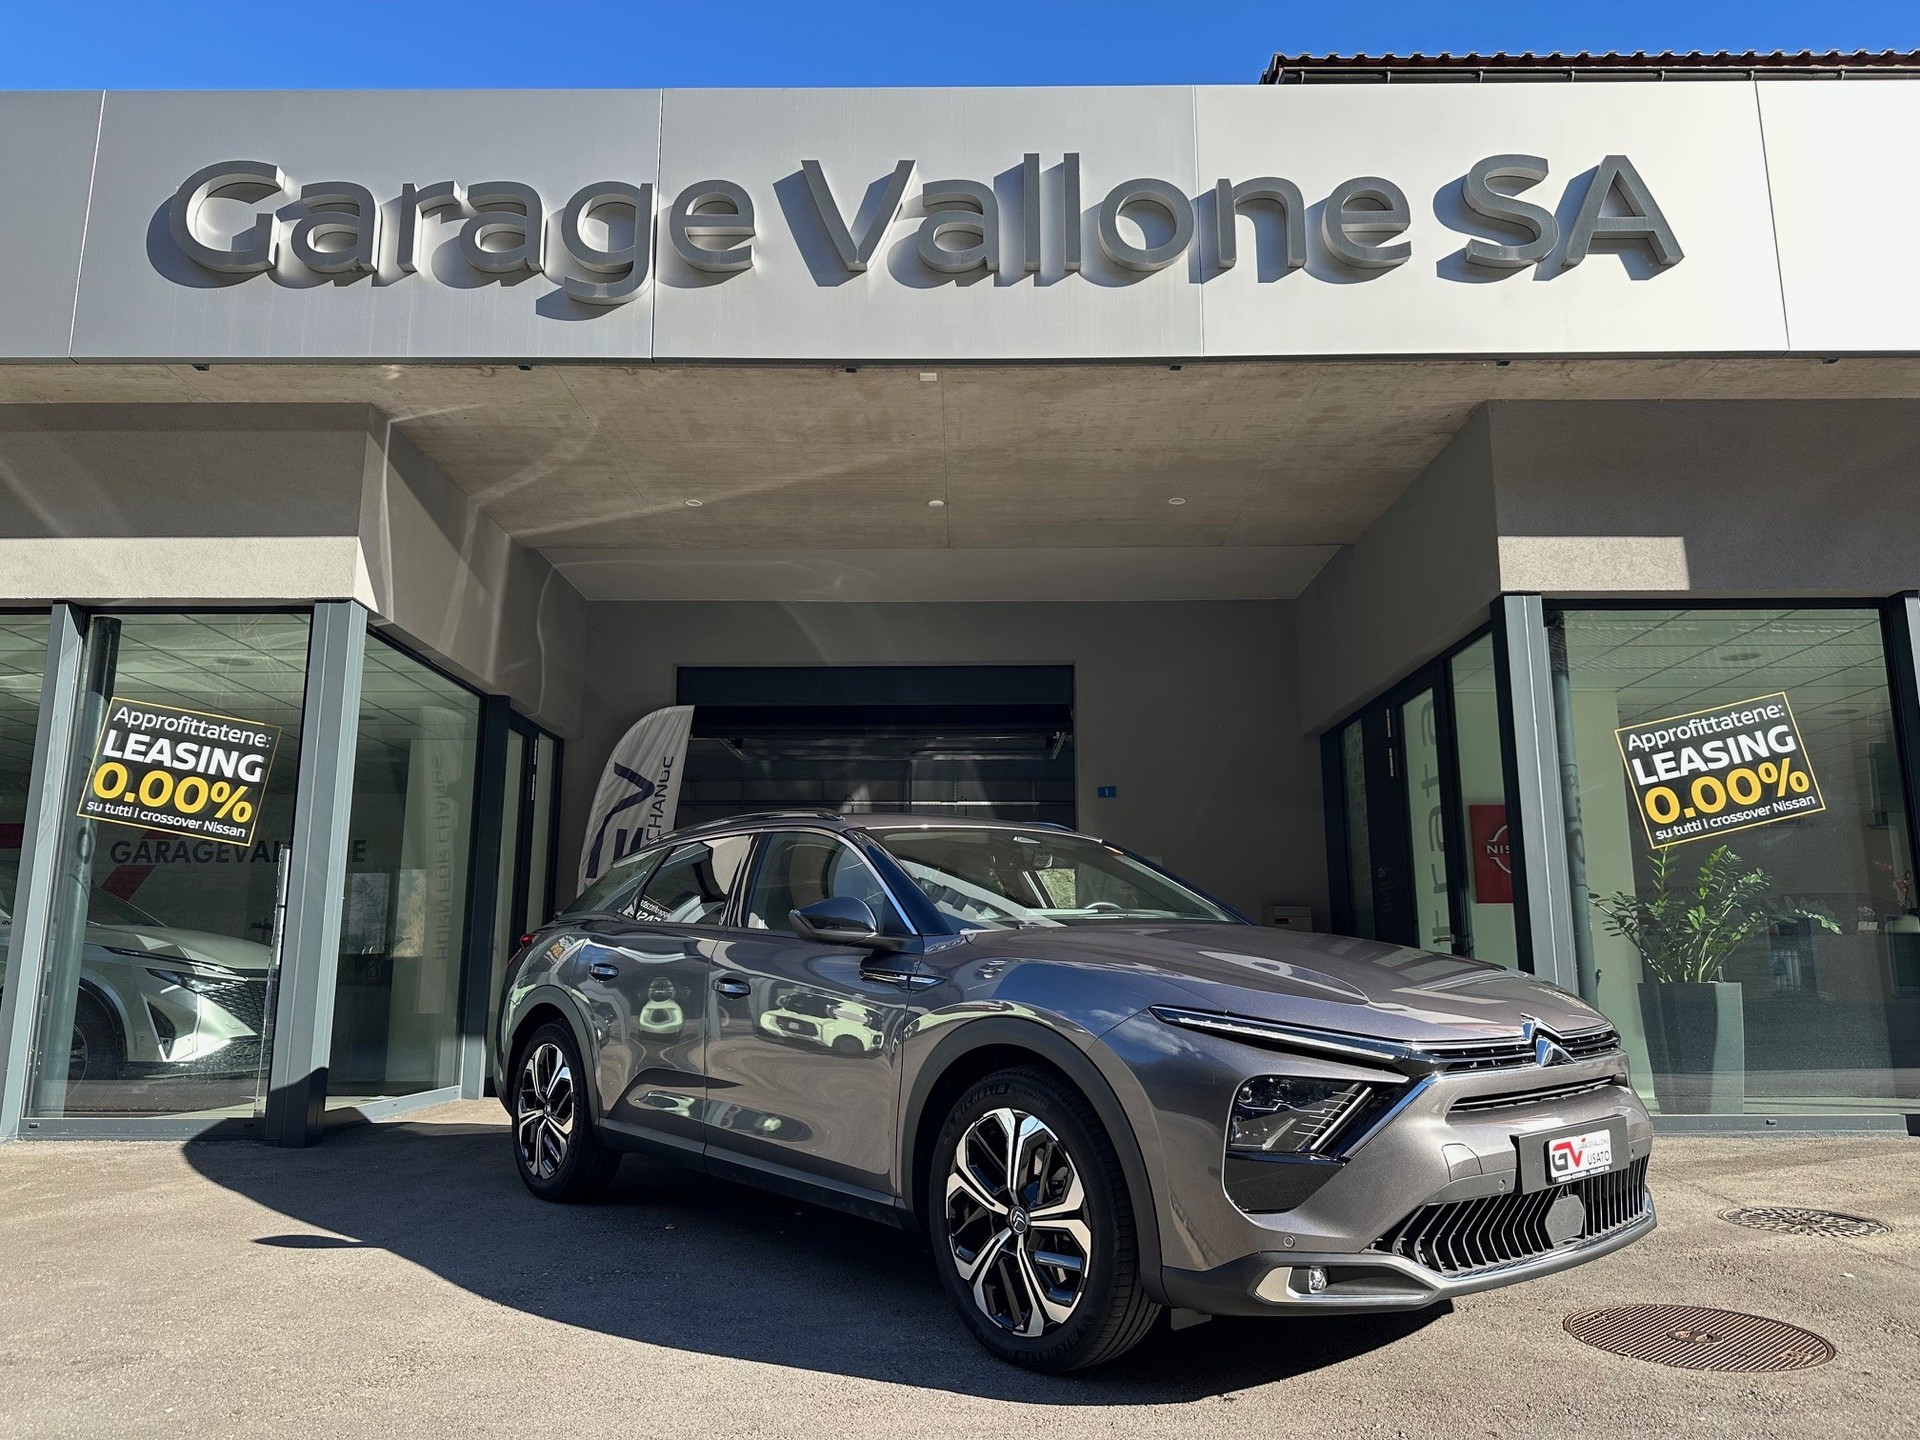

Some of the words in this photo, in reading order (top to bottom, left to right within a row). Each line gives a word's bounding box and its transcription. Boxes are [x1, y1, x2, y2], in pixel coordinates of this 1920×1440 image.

[167, 160, 757, 306] Garage
[799, 152, 1412, 272] Vallone
[1463, 153, 1686, 267] SA
[113, 706, 272, 748] Approfittatene:
[1627, 704, 1786, 752] Approfittatene:
[102, 729, 265, 783] LEASING
[1631, 724, 1798, 786] LEASING
[92, 761, 253, 823] 0.00%
[1644, 757, 1811, 825] 0.00%
[86, 801, 104, 812] su
[104, 803, 133, 818] tutti
[140, 810, 202, 830] crossover
[203, 821, 246, 838] Nissan
[1656, 827, 1673, 840] su
[1672, 820, 1702, 837] tutti
[1711, 806, 1771, 828] crossover
[1772, 794, 1816, 813] Nissan
[1587, 1150, 1611, 1165] USATO
